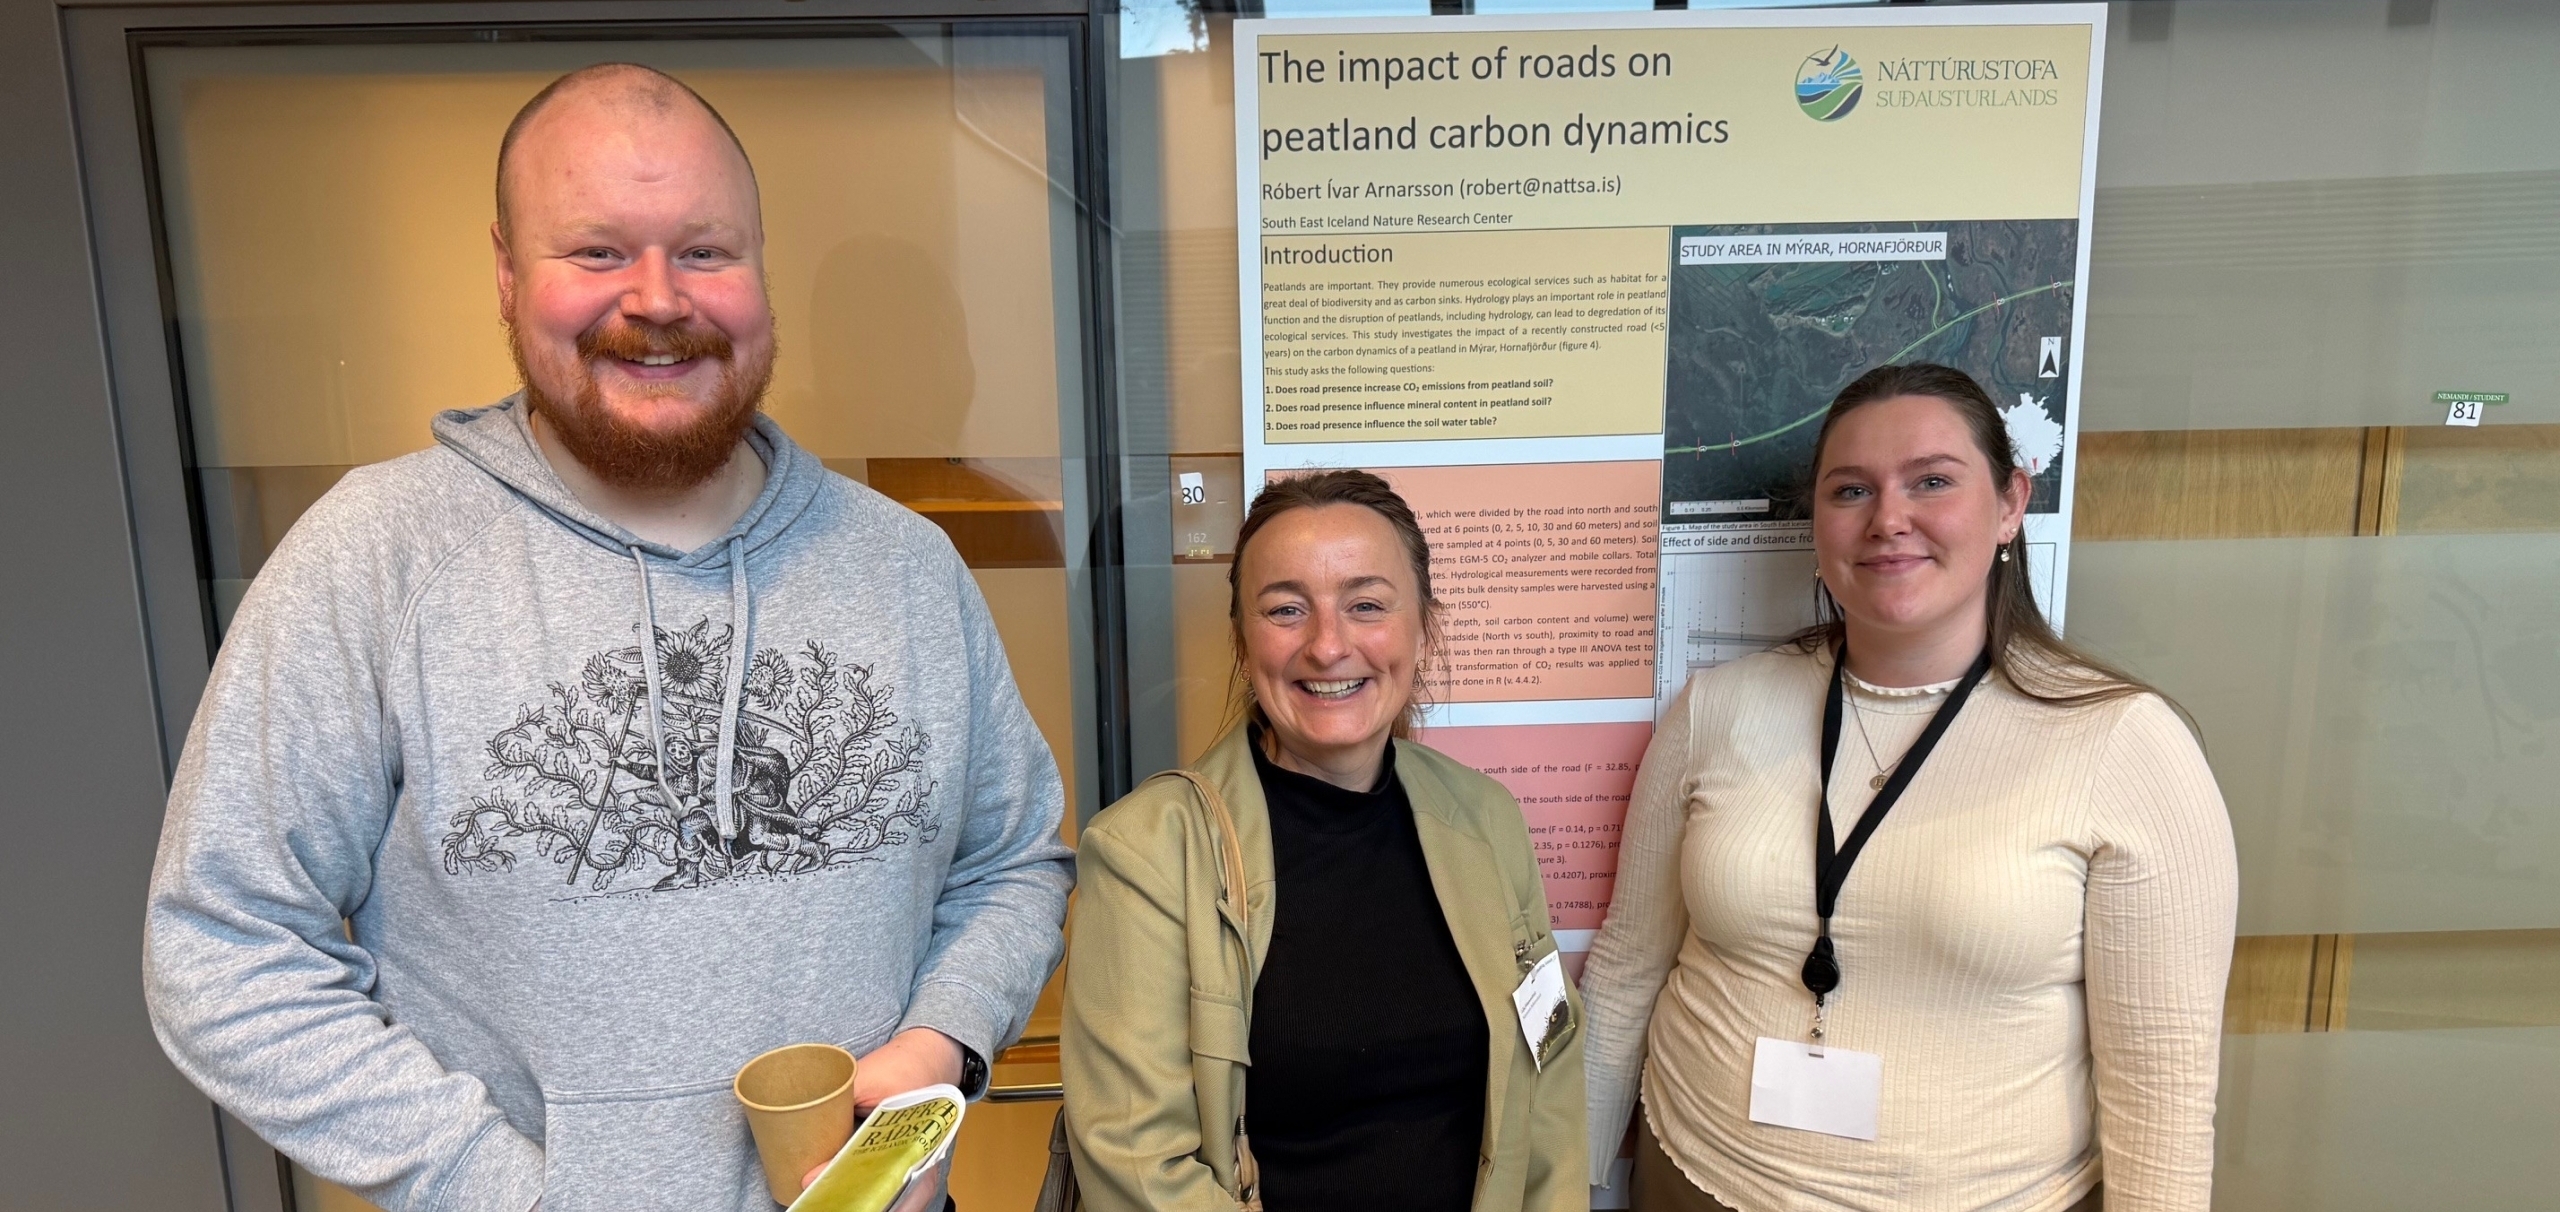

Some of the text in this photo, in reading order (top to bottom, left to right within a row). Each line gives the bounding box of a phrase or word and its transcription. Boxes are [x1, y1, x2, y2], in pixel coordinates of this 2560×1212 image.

[1260, 45, 1671, 90] The impact of roads on
[1878, 57, 2058, 82] NÁTTÚRUSTOFA
[1876, 89, 2058, 108] SUÐAUSTURLANDS
[1262, 112, 1729, 160] peatland carbon dynamics
[1262, 172, 1621, 201] Róbert Ívar Arnarsson (robert@nattsa.is)
[1262, 212, 1512, 229] South East Iceland Nature Research Center
[1264, 244, 1393, 264] Introduction
[1681, 238, 1942, 258] STUDY AREA IN MÝRAR, HORNAFJÖRÐUR
[1263, 281, 1306, 291] Peatlands
[1327, 279, 1374, 292] important.
[1376, 279, 1399, 290] They
[1402, 278, 1436, 290] provide
[1487, 276, 1531, 288] ecological
[1534, 275, 1570, 284] services
[1572, 274, 1594, 284] such
[1610, 273, 1642, 283] habitat
[1644, 273, 1658, 282] for
[1263, 298, 1286, 310] great
[1288, 298, 1308, 307] deal
[1309, 297, 1319, 306] of
[1321, 296, 1372, 308] biodiversity
[1374, 296, 1391, 305] and
[1405, 294, 1436, 304] carbon
[1438, 294, 1462, 303] sinks.
[1464, 293, 1510, 305] Hydrology
[1512, 292, 1534, 304] plays
[1550, 291, 1594, 303] important
[1596, 290, 1614, 300] role
[1616, 290, 1624, 299] in
[1627, 289, 1666, 301] peatland
[1264, 363, 1434, 377] This study asks the following questions:
[1266, 385, 1274, 394] 1.
[1275, 384, 1297, 394] Does
[1300, 384, 1320, 393] road
[1322, 385, 1361, 394] presence
[1364, 382, 1400, 392] increase
[1422, 380, 1464, 390] emissions
[1467, 380, 1488, 389] from
[1491, 379, 1530, 391] peatland
[1533, 378, 1552, 388] soil?
[2453, 402, 2476, 419] 81
[1264, 416, 1497, 431] 3. Does road presence influence the soil water table?
[1182, 486, 1204, 504] 80
[1425, 509, 1451, 518] which
[1478, 508, 1510, 517] divided
[1513, 508, 1524, 518] by
[1526, 507, 1541, 515] the
[1544, 507, 1564, 515] road
[1566, 506, 1584, 514] into
[1586, 505, 1611, 514] north
[1614, 505, 1630, 513] and
[1633, 504, 1658, 513] south
[1187, 533, 1207, 543] 162
[1663, 534, 1814, 547] Effect of side and distance fro
[1432, 586, 1447, 594] the
[1449, 586, 1464, 596] pits
[1466, 585, 1485, 594] bulk
[1487, 584, 1518, 595] density
[1520, 584, 1555, 594] samples
[1580, 582, 1623, 591] harvested
[1625, 582, 1648, 592] using
[1456, 661, 1518, 670] transformation
[1522, 660, 1531, 668] of
[1555, 659, 1583, 668] results
[1608, 658, 1639, 669] applied
[1644, 658, 1652, 666] to
[1482, 765, 1508, 774] south
[1510, 765, 1528, 773] side
[1530, 764, 1541, 773] of
[1543, 764, 1558, 772] the
[1561, 764, 1581, 772] road
[1584, 763, 1592, 774] (F
[1604, 763, 1632, 773] 32.85,
[1523, 793, 1630, 803] the south side of the road
